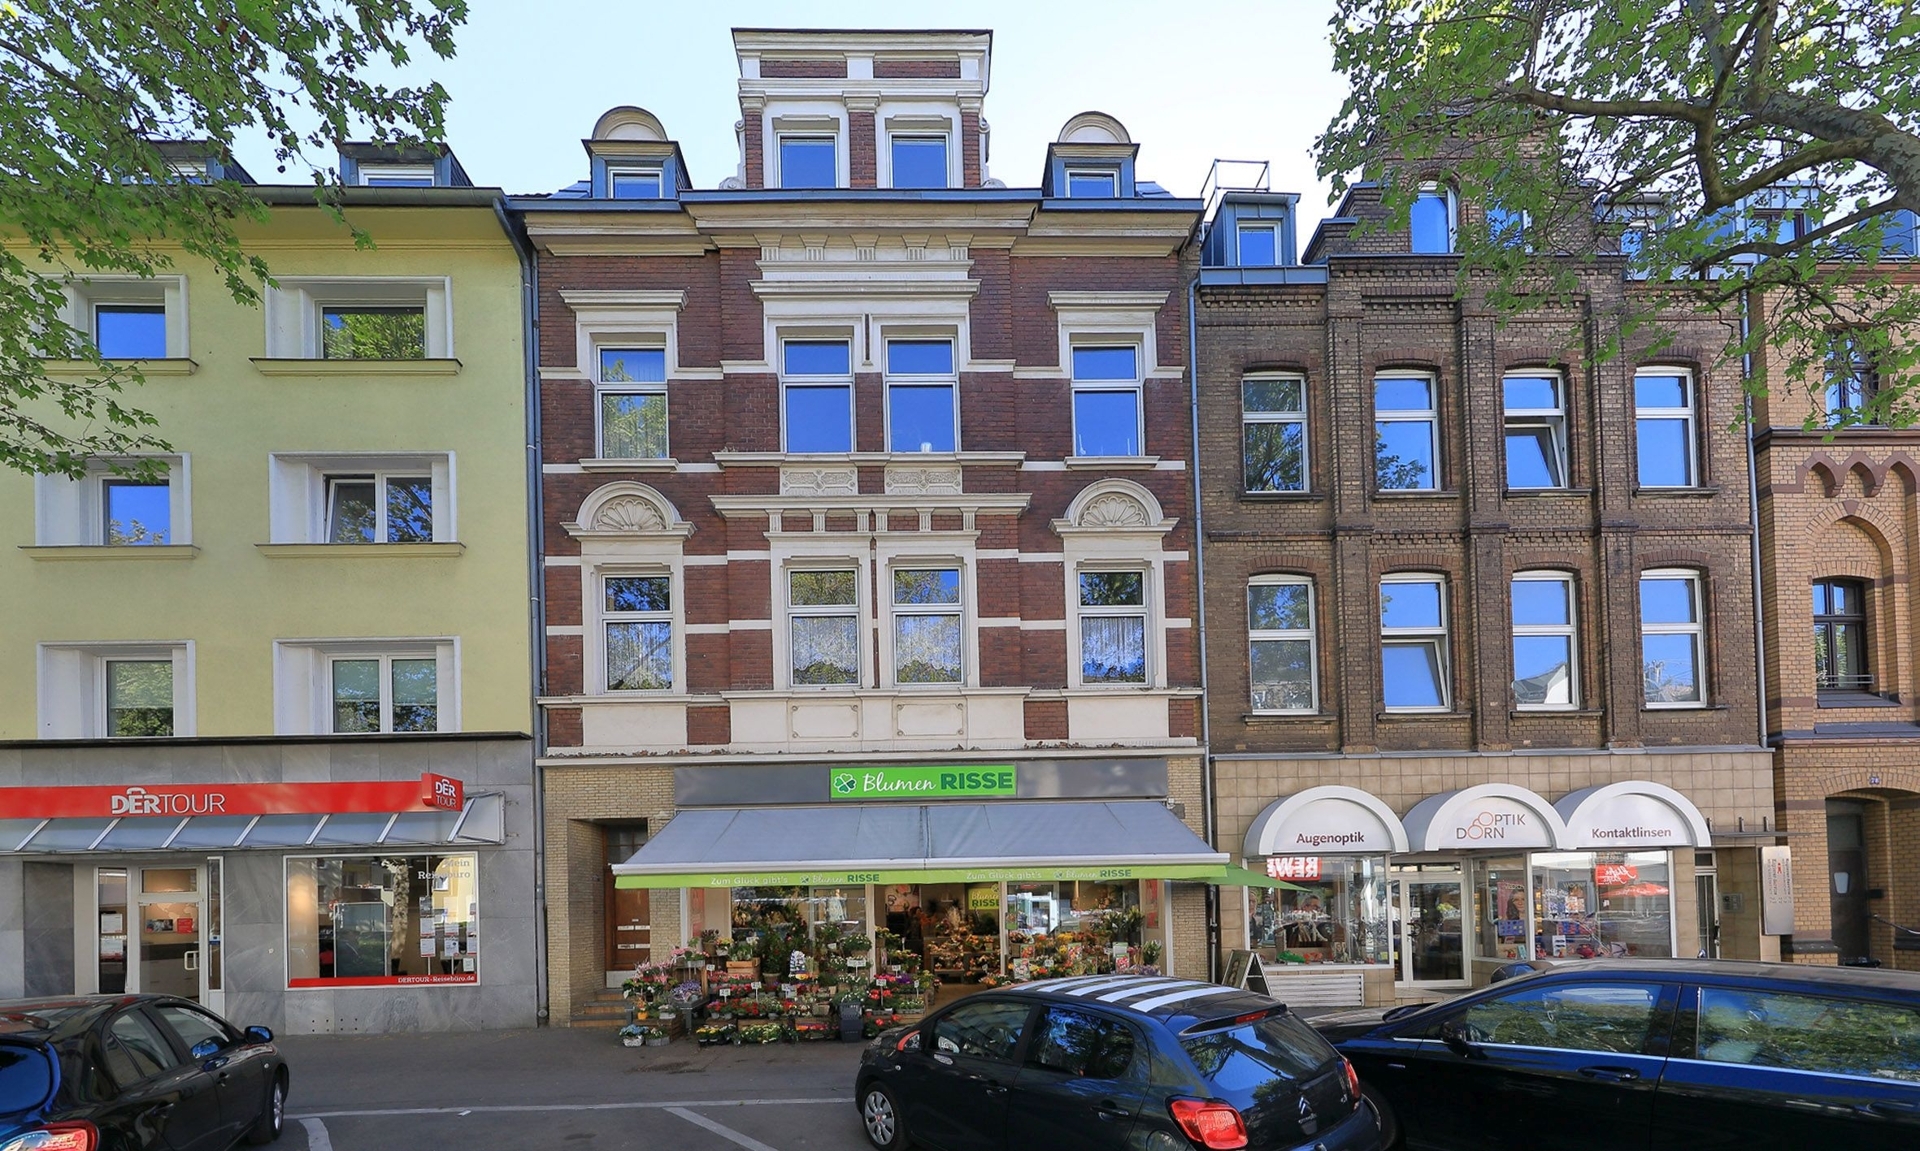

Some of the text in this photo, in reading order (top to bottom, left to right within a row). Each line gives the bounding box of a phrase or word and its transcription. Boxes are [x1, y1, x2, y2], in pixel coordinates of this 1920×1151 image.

[435, 779, 457, 797] DER
[862, 772, 1013, 792] Blumen RISSE
[111, 788, 226, 814] DERTOUR
[436, 795, 457, 807] TOUR
[1478, 811, 1526, 826] OPTIK
[1296, 832, 1365, 847] Augenoptik
[1456, 825, 1504, 840] DORN
[1591, 827, 1672, 838] Kontaktlinsen
[711, 873, 880, 885] Zum Glück gibt's Blumen RISSE
[966, 869, 1132, 880] Zum Glück gibt's Blumen RISSE
